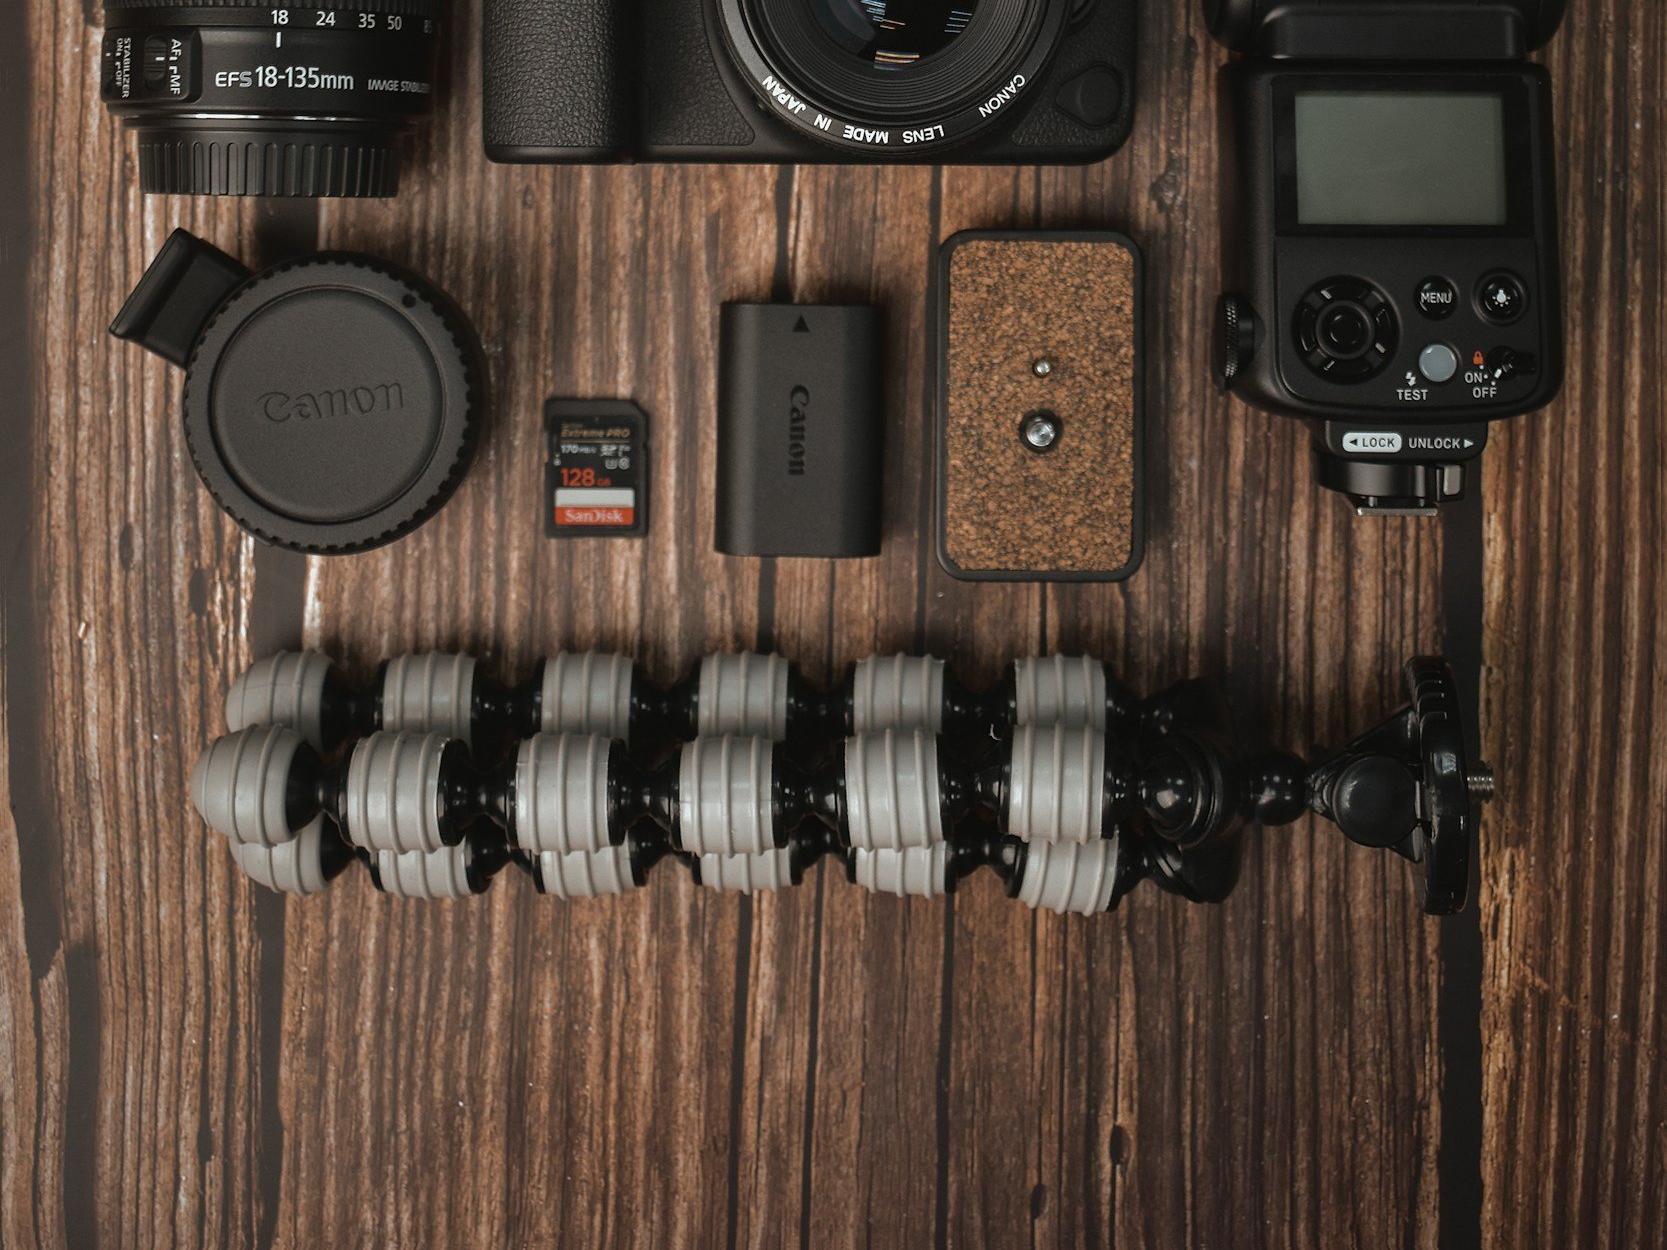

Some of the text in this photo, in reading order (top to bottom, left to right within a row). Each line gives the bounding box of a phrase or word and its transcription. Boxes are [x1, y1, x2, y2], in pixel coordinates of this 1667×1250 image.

[271, 9, 289, 26] 18
[315, 11, 336, 27] 24
[358, 13, 376, 29] 35
[387, 15, 402, 31] 50
[121, 37, 132, 99] STABILIZER
[169, 38, 182, 96] AF MF
[215, 65, 355, 91] EFS 18-135mm
[367, 78, 399, 92] IMAGE
[761, 73, 1026, 145] CANON LENS MADE IN JAPAN
[1420, 292, 1453, 304] MENU
[1464, 372, 1483, 384] ON
[1396, 389, 1428, 401] TEST
[1472, 386, 1498, 398] OFF
[255, 382, 404, 423] Canon
[788, 383, 810, 477] Canon
[1362, 437, 1395, 448] LOCK
[1408, 437, 1461, 449] UNLOCK
[561, 467, 595, 488] 128
[565, 507, 623, 523] SanDisk
